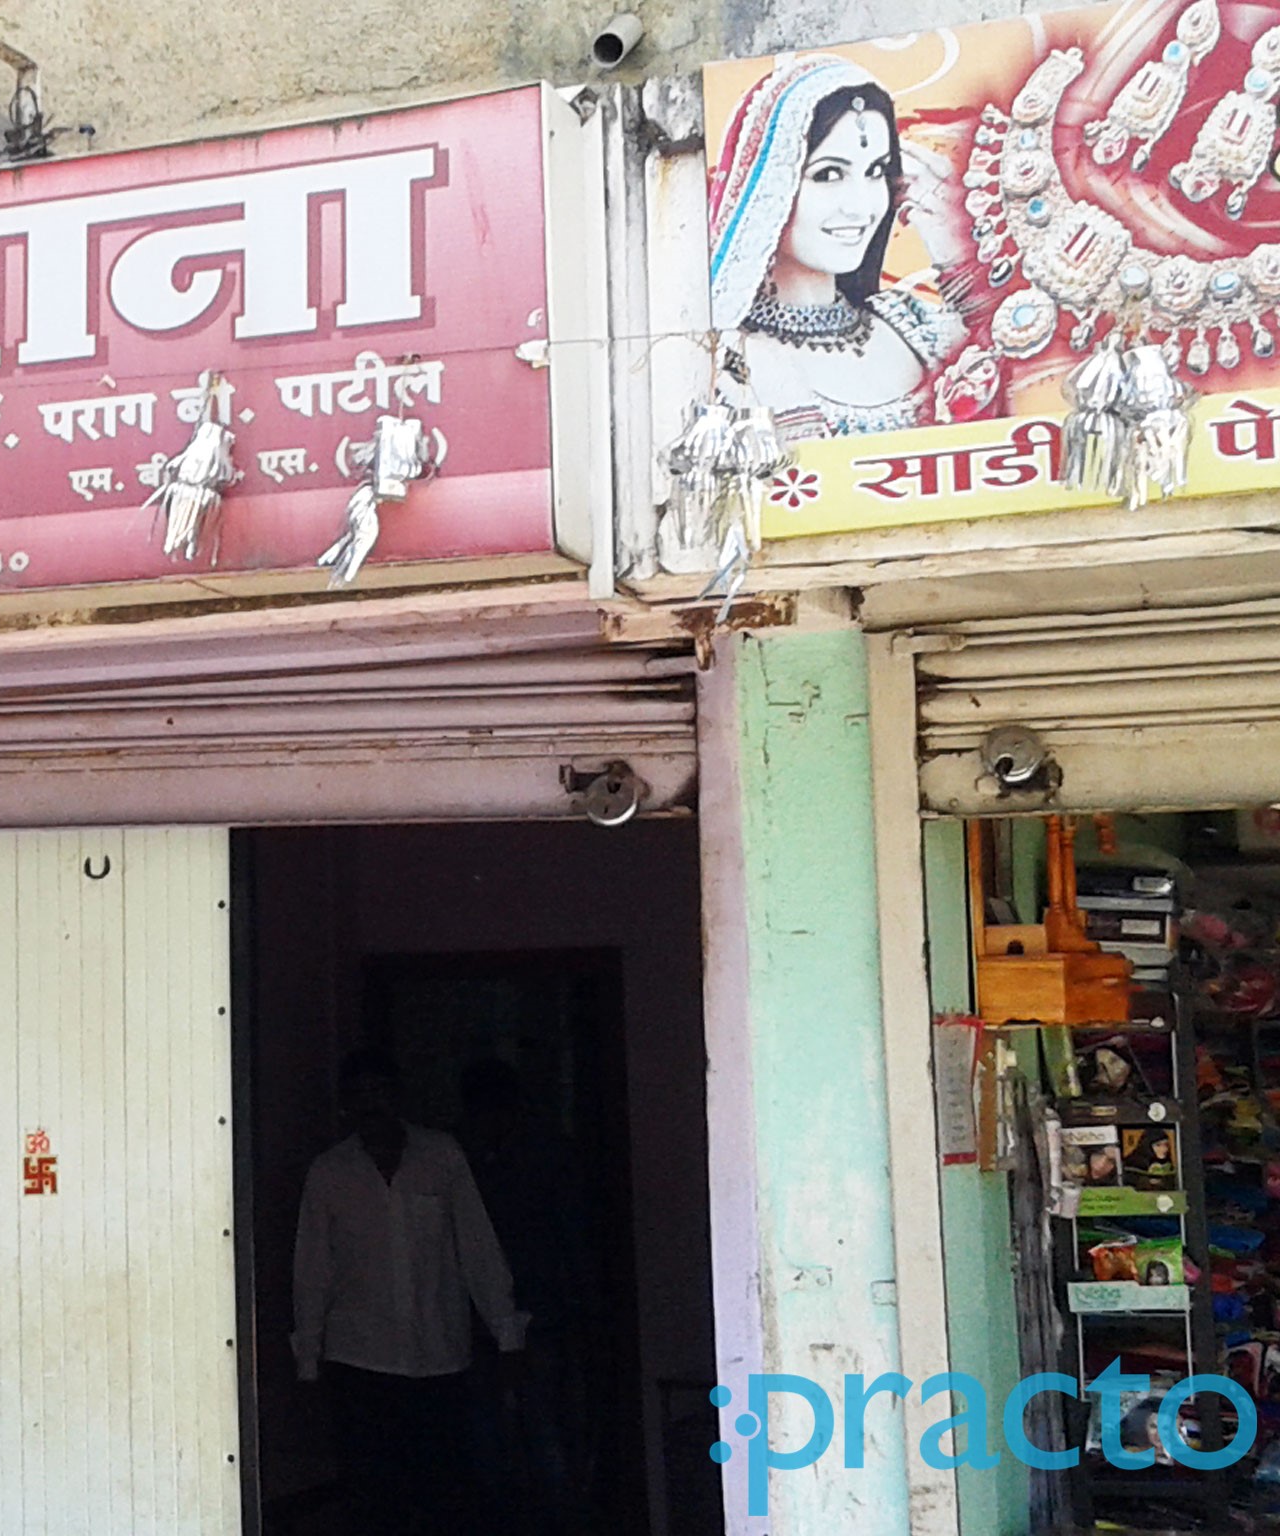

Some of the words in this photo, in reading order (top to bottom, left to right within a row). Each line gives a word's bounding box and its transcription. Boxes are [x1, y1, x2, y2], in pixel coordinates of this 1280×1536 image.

[38, 392, 157, 443] पराग
[274, 350, 445, 417] पाटील
[69, 467, 124, 501] एम.
[257, 448, 319, 483] एस.
[853, 420, 1065, 498] साडी
